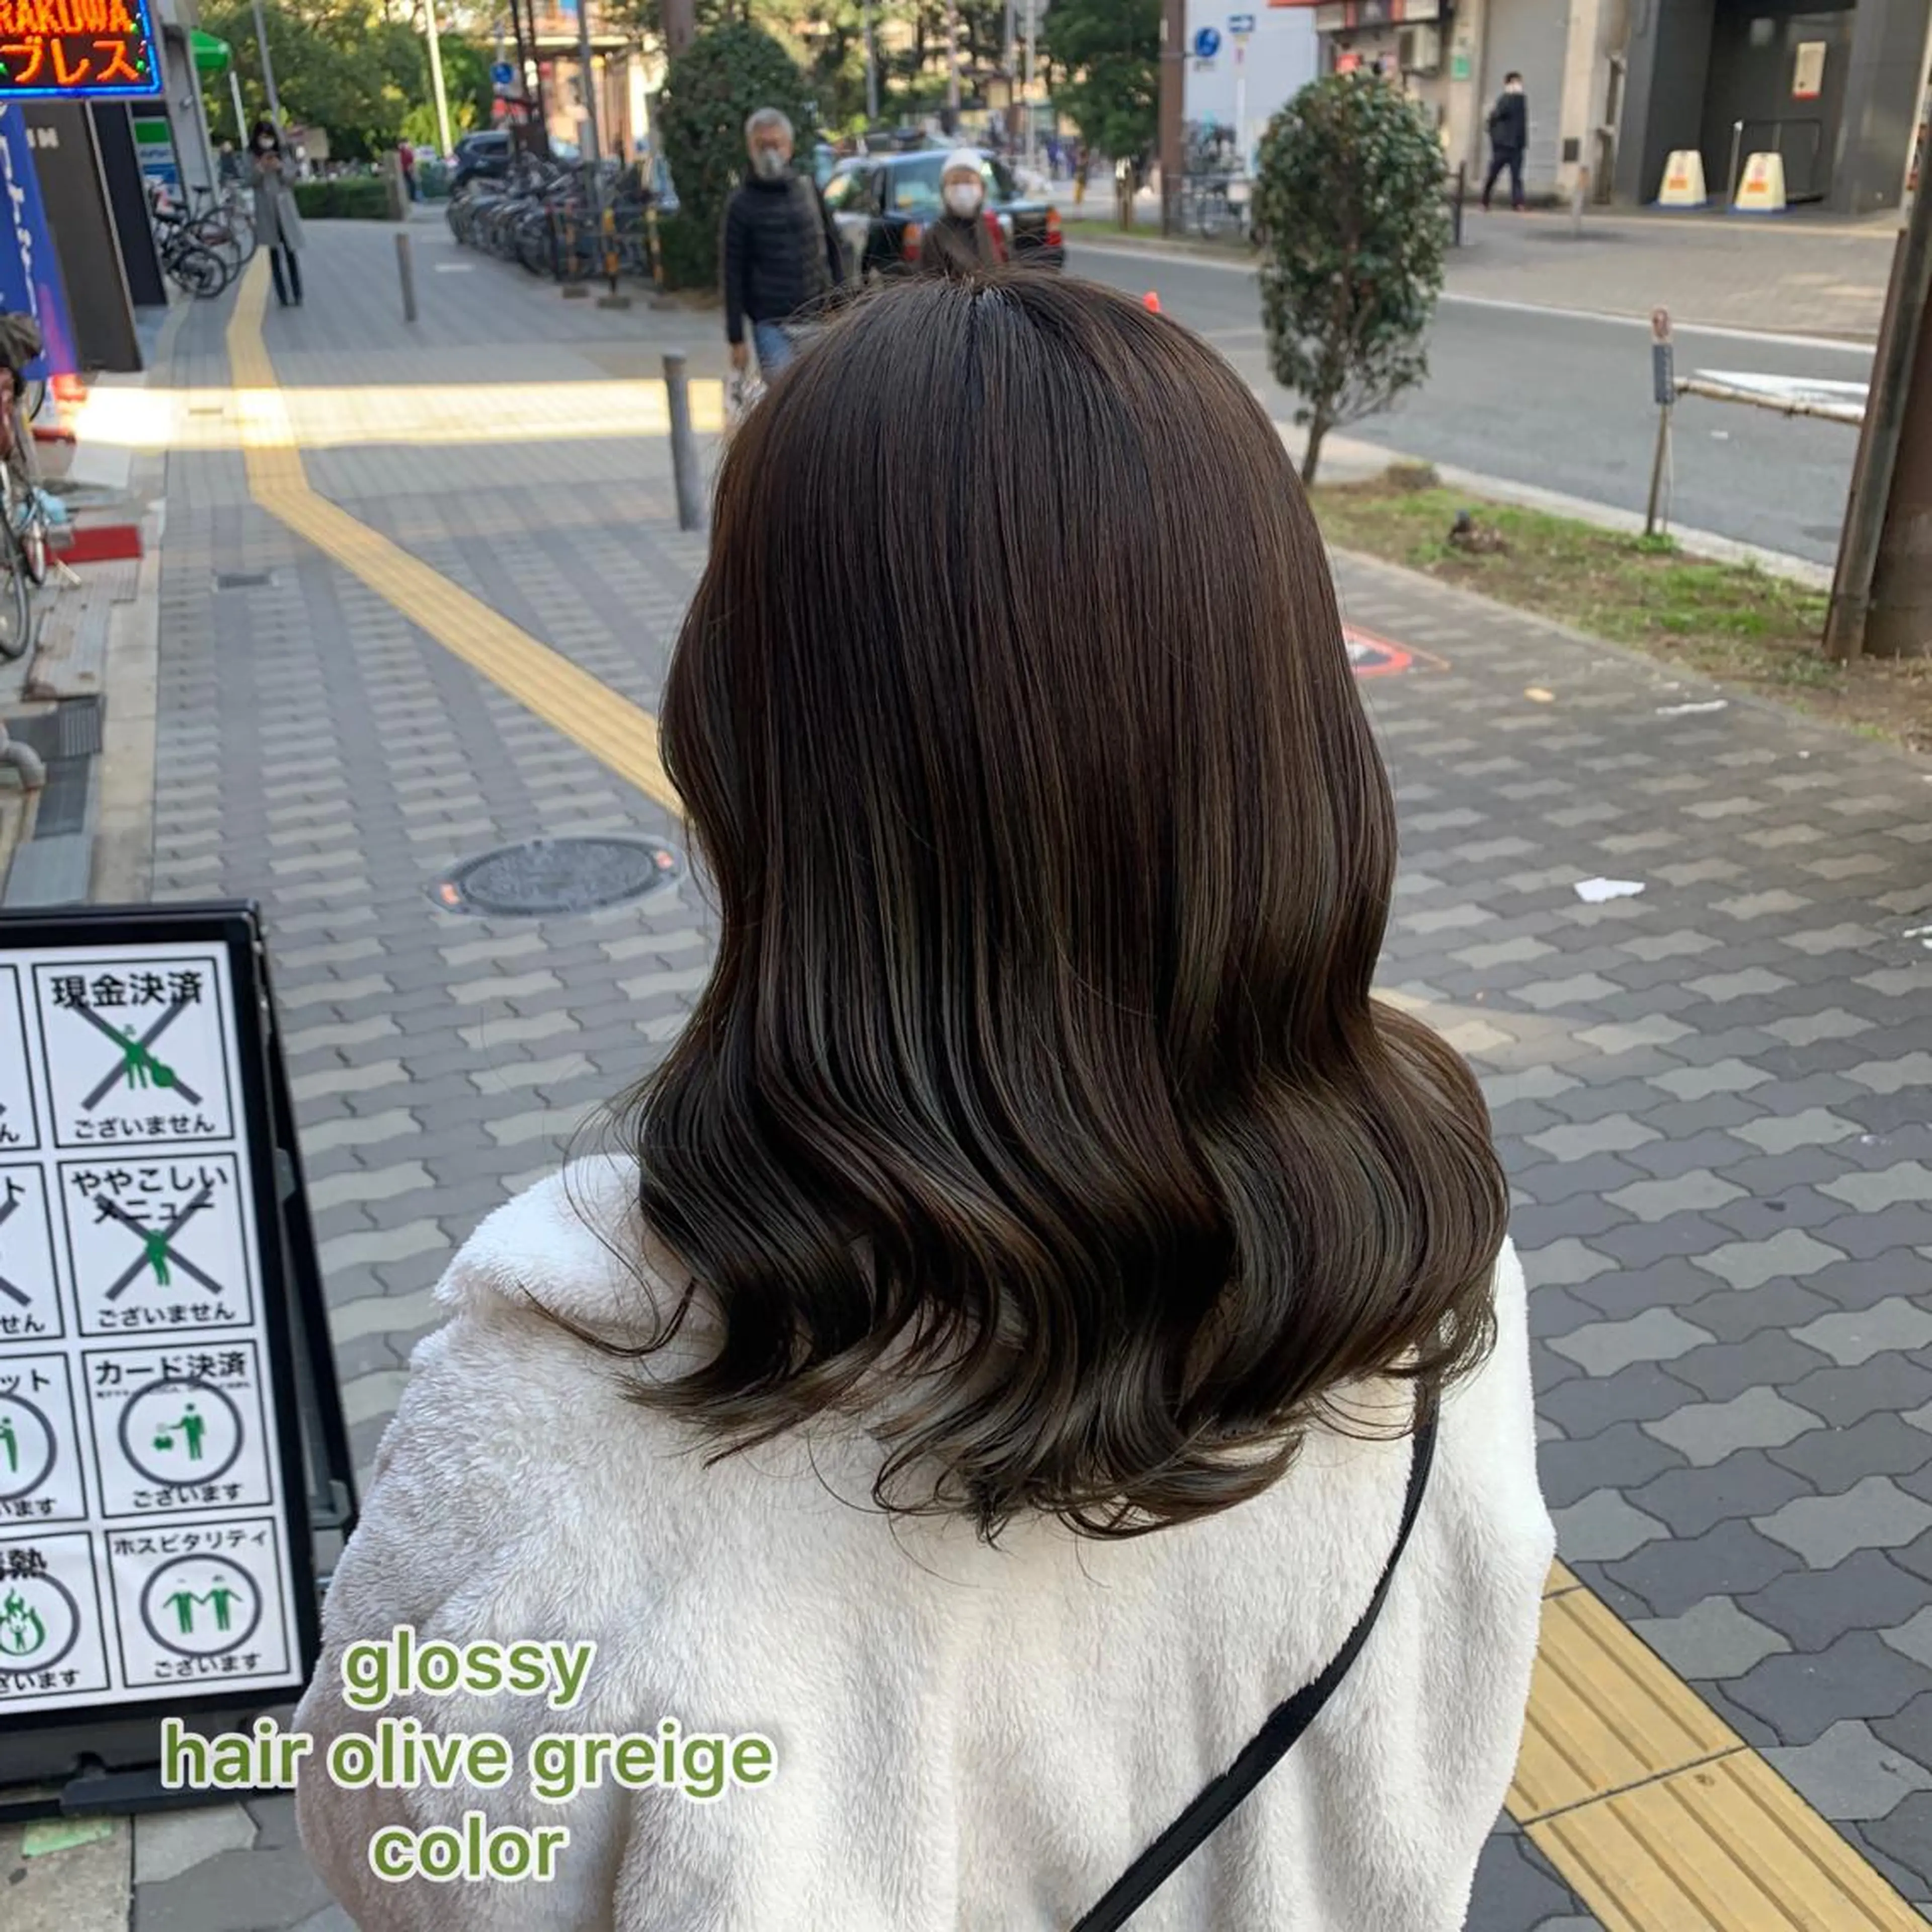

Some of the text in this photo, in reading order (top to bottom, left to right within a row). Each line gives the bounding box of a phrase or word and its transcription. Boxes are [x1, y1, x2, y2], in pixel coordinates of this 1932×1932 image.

[0, 36, 138, 85] ブレス
[50, 971, 202, 1008] 現金決済
[74, 1114, 215, 1139] ございません
[71, 1166, 227, 1196] ややこしい
[94, 1200, 215, 1224] メニュー
[99, 1302, 235, 1328] ございません
[95, 1351, 246, 1386] カード決済
[133, 1483, 242, 1509] ございます
[114, 1530, 267, 1556] ホスピタリティ
[0, 1547, 48, 1579] 熱
[154, 1653, 262, 1678] ございます
